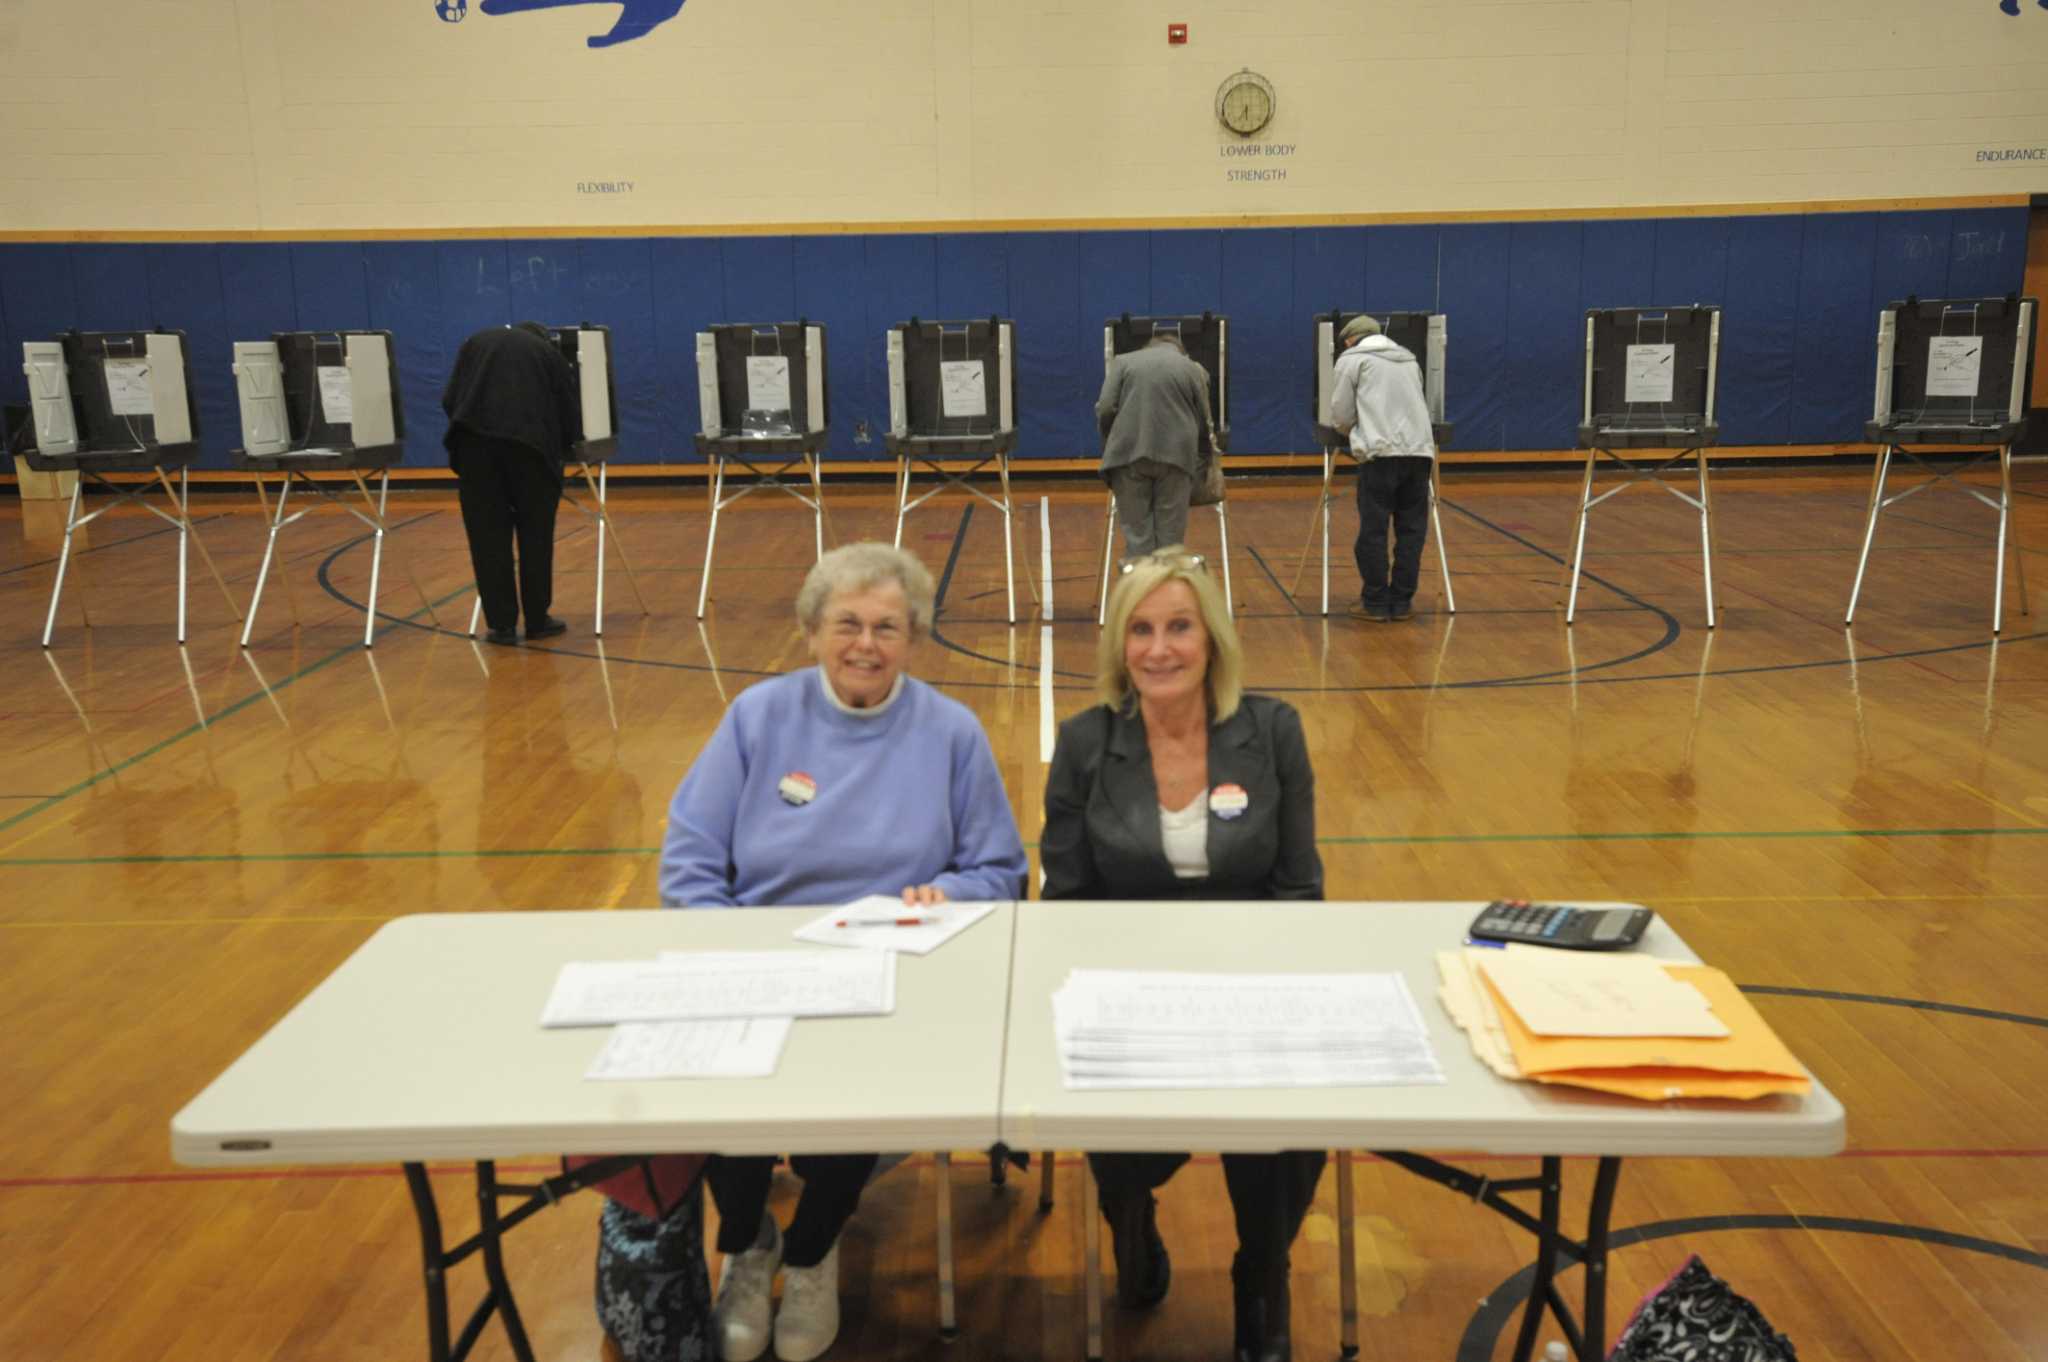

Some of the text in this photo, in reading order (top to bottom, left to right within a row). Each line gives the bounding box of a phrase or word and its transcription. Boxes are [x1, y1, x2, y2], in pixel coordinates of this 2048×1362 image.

[1220, 144, 1296, 157] LOWER BODY
[1976, 148, 2048, 162] ENDURANCE
[1226, 168, 1287, 182] STRENGTH
[577, 182, 634, 193] FLEXIBILITY
